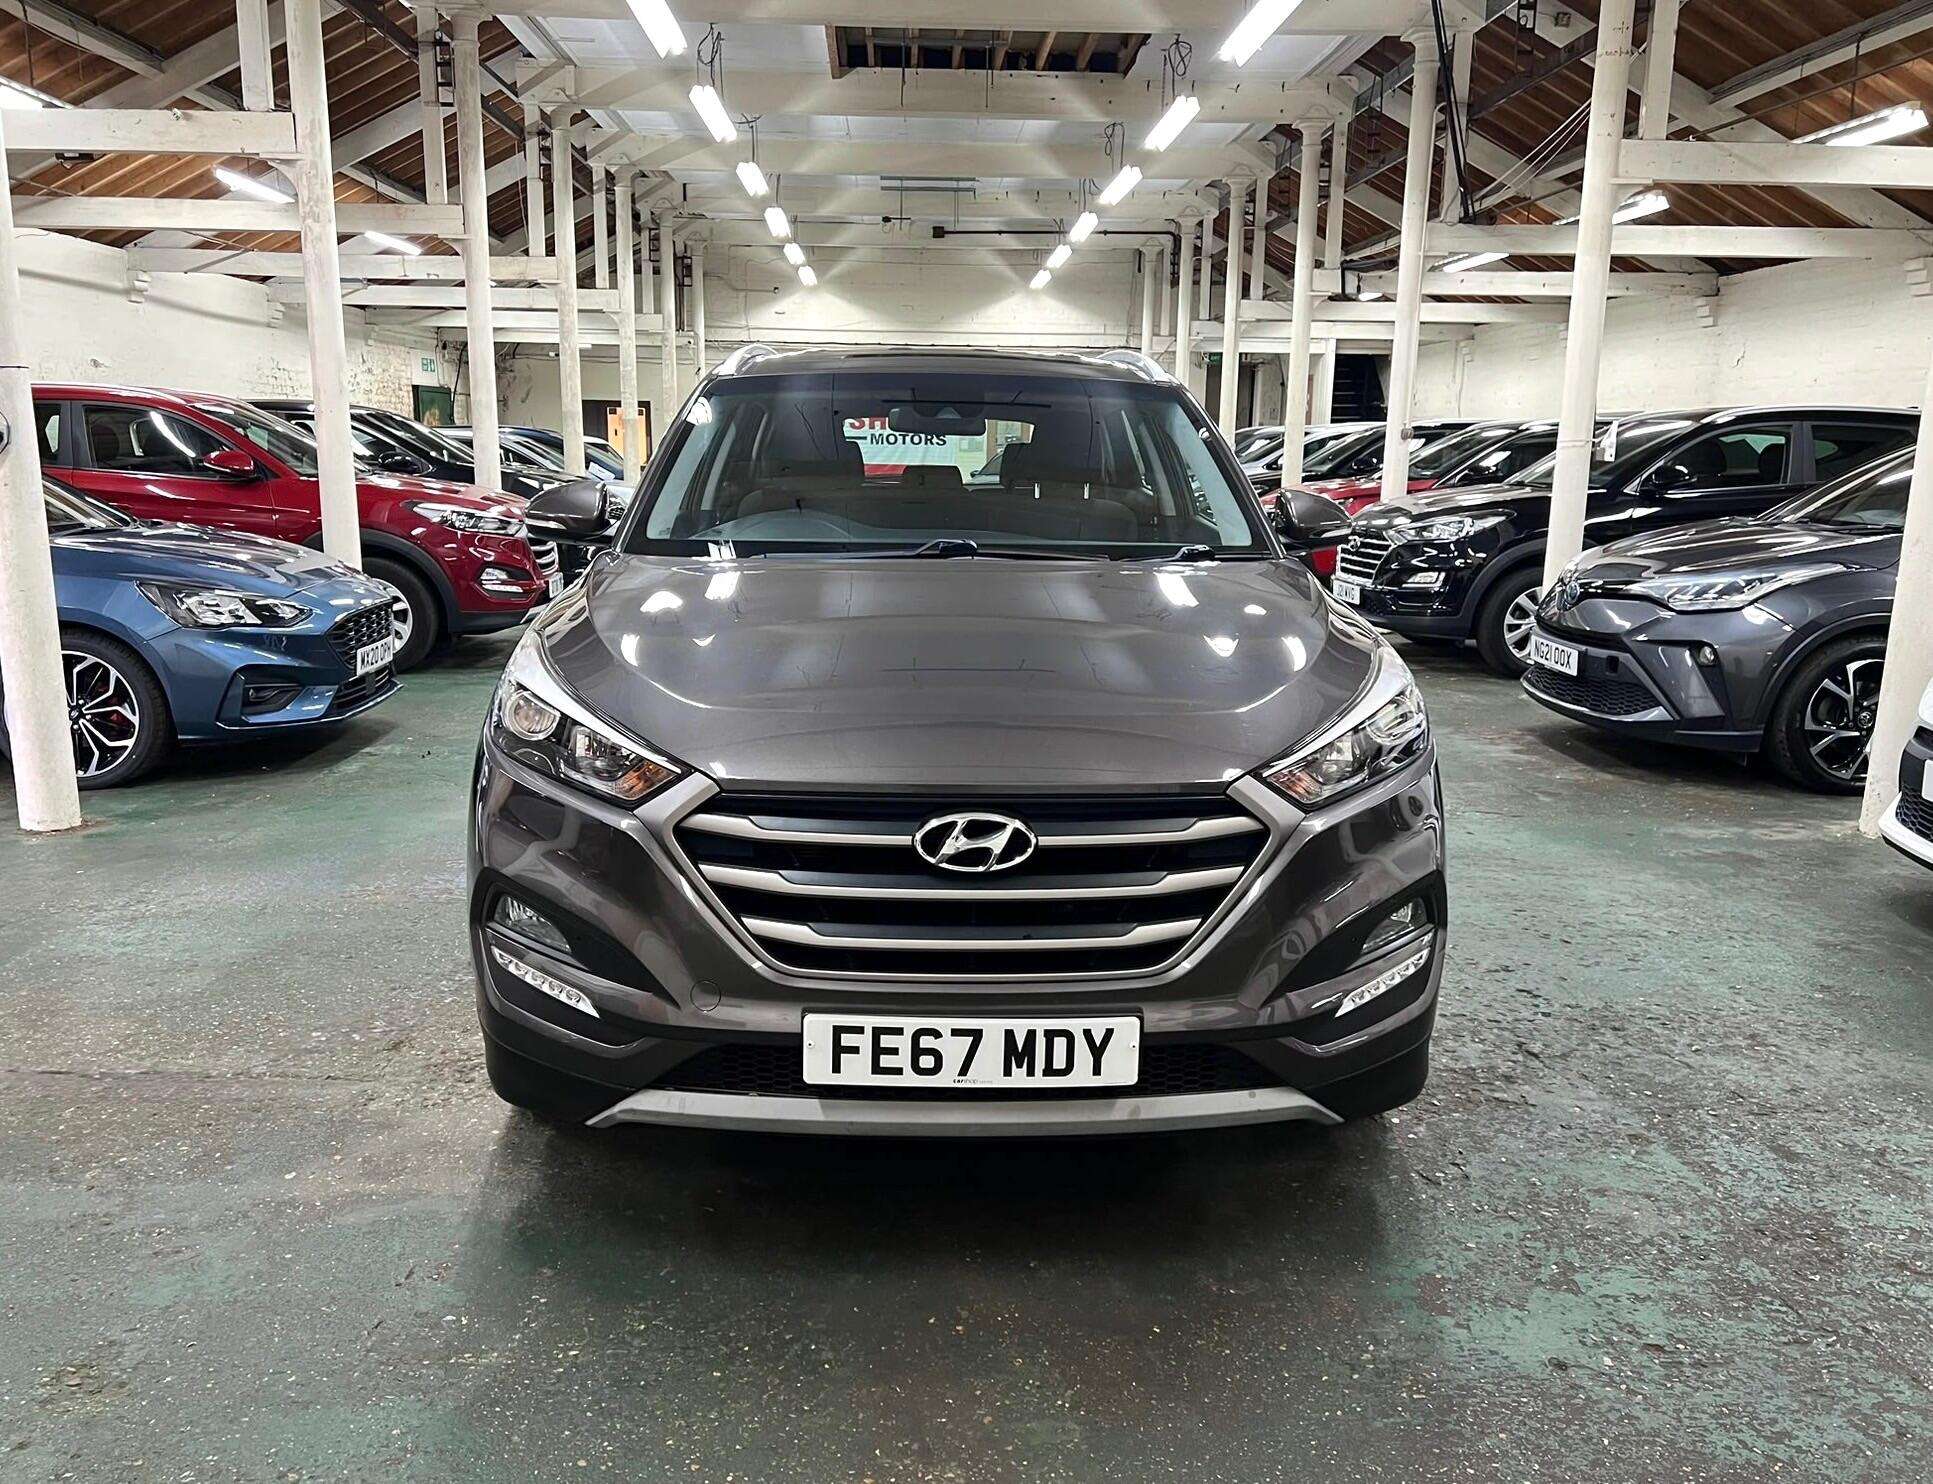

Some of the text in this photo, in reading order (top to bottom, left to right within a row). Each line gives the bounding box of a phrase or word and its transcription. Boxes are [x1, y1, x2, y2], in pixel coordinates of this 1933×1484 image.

[870, 433, 947, 446] MOTORS
[1534, 639, 1572, 669] NG21 OOX
[832, 1025, 1115, 1078] FE67 MDY
